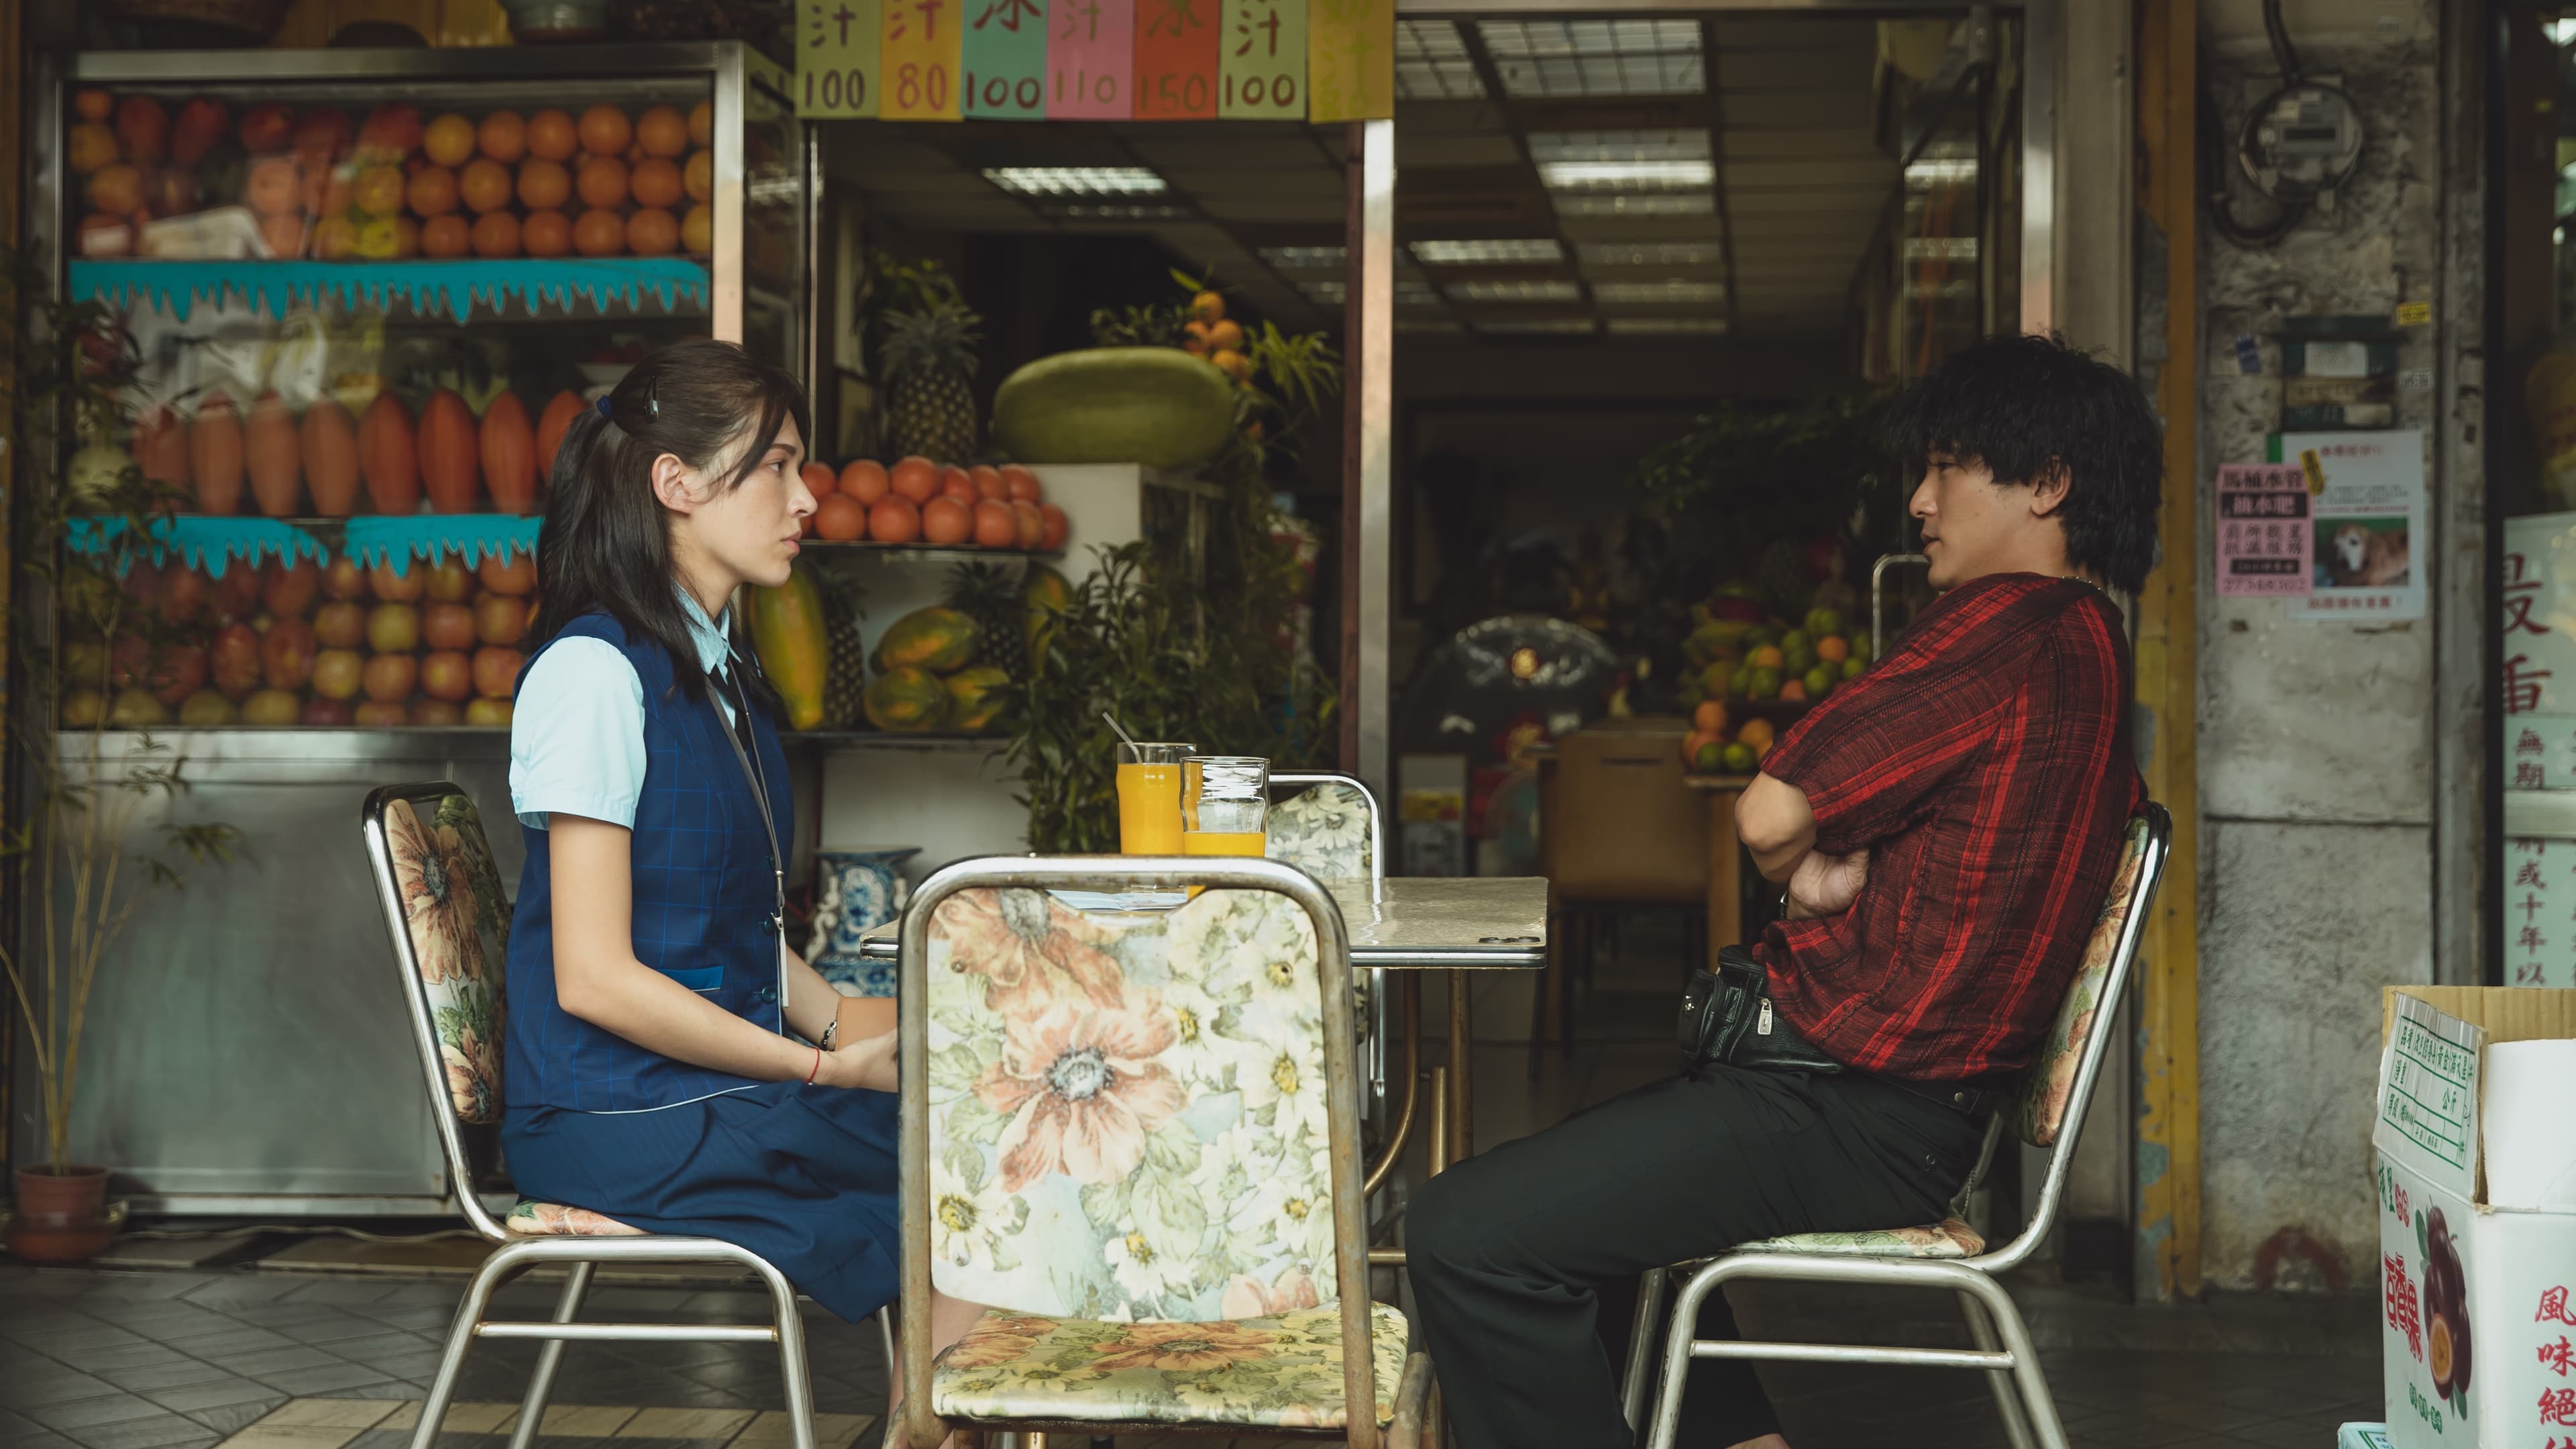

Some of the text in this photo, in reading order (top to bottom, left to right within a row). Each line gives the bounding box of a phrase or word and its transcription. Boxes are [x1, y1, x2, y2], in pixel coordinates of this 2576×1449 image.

[810, 3, 857, 48] 汁
[889, 0, 944, 42] 汁
[1235, 8, 1281, 57] 汁
[806, 68, 865, 109] 100
[896, 62, 947, 112] 80
[967, 71, 1041, 110] 100
[1055, 68, 1117, 105] 110
[1141, 72, 1207, 113] 150
[1225, 74, 1296, 108] 100
[2383, 1251, 2423, 1363] 百香果
[2534, 1284, 2576, 1449] 風味絕
